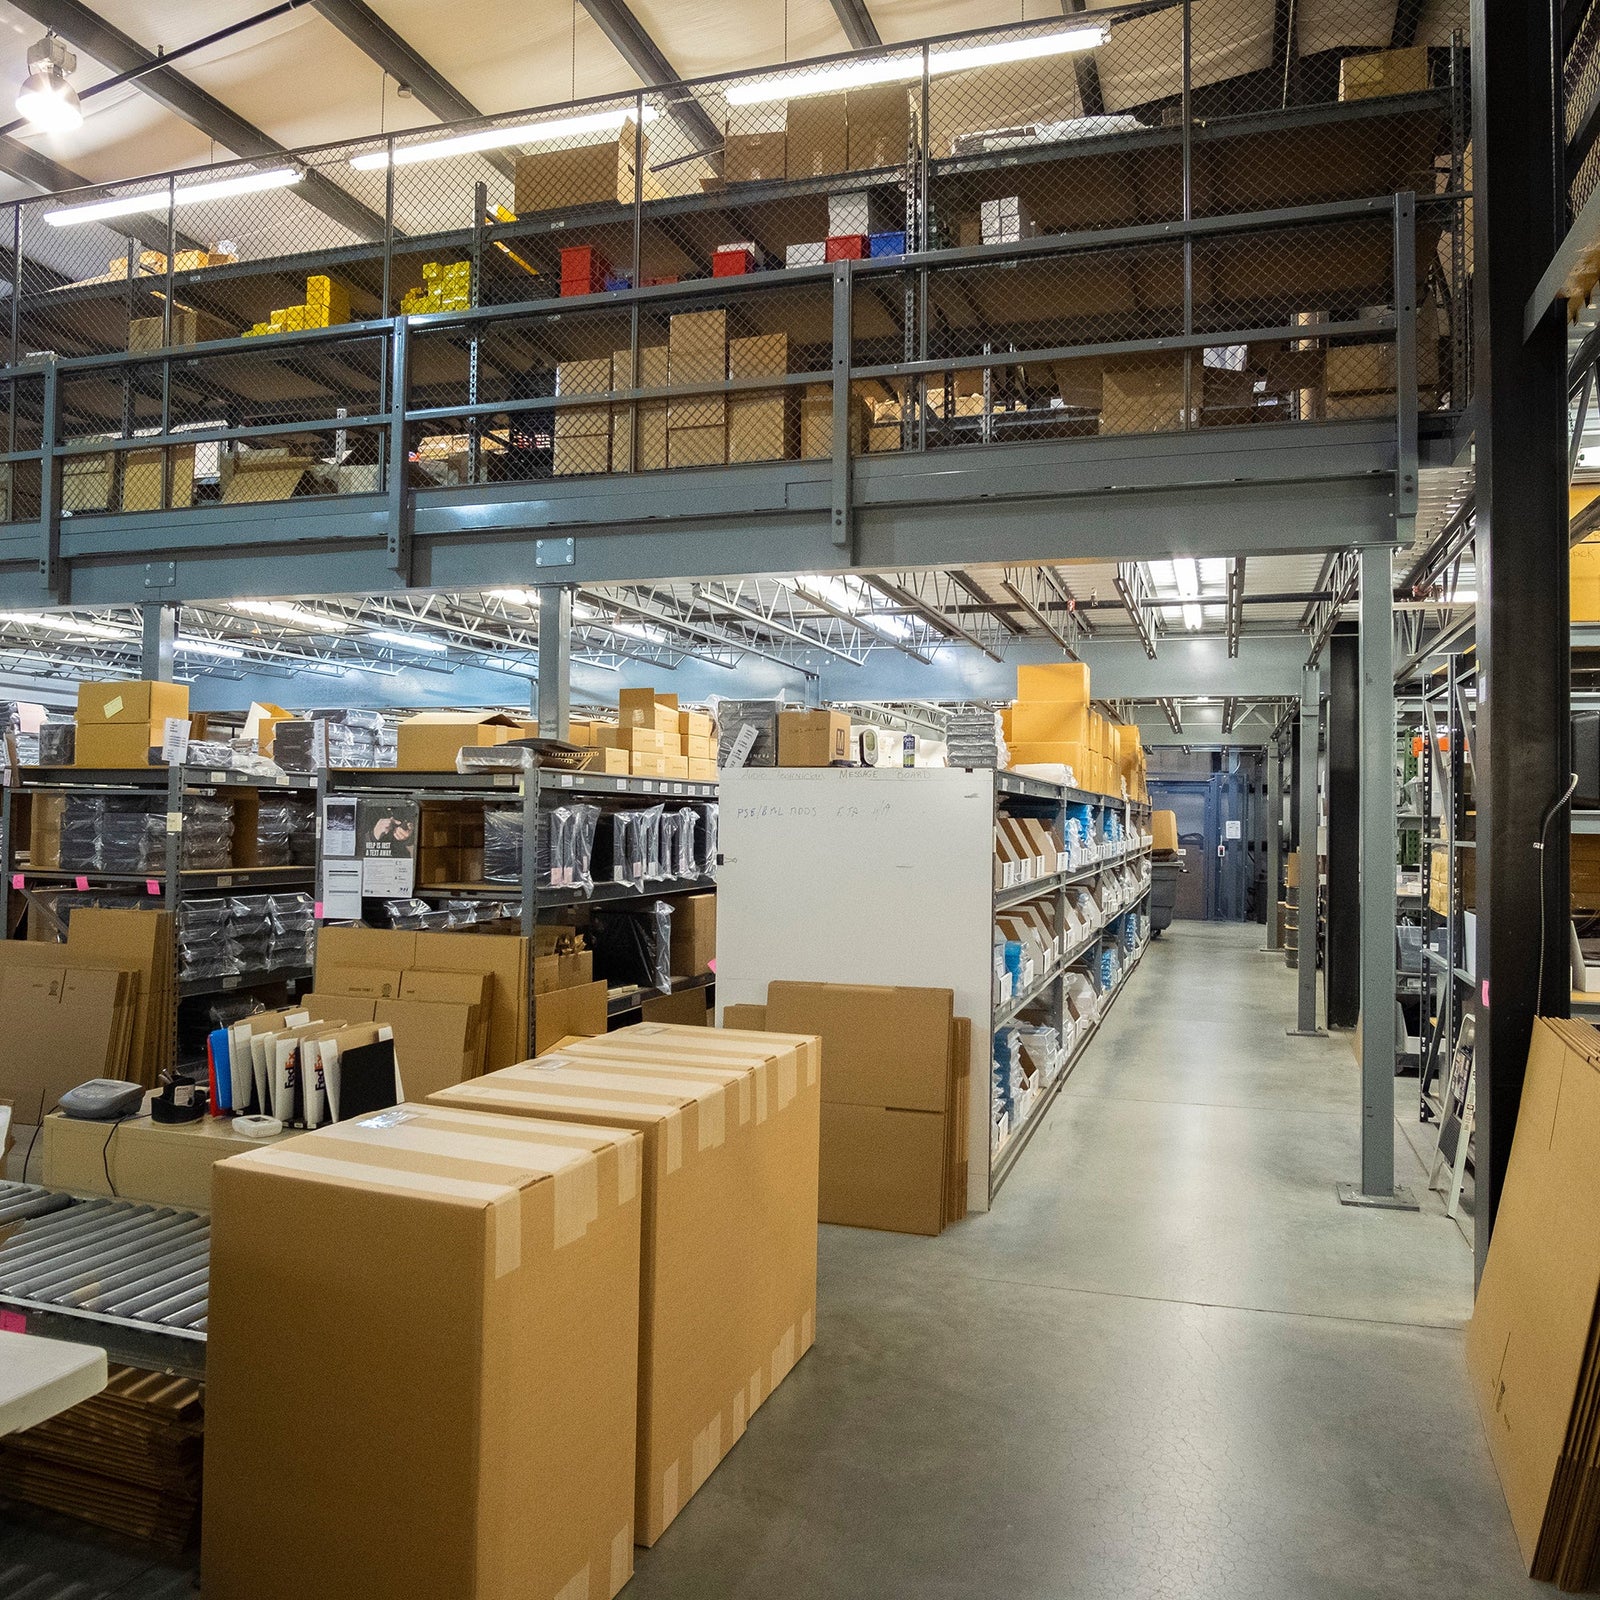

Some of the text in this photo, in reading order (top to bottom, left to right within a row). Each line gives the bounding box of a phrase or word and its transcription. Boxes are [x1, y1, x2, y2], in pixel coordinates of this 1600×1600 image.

[839, 769, 879, 779] MESSAGE
[896, 770, 931, 779] BOARD
[284, 1052, 295, 1089] FedEx
